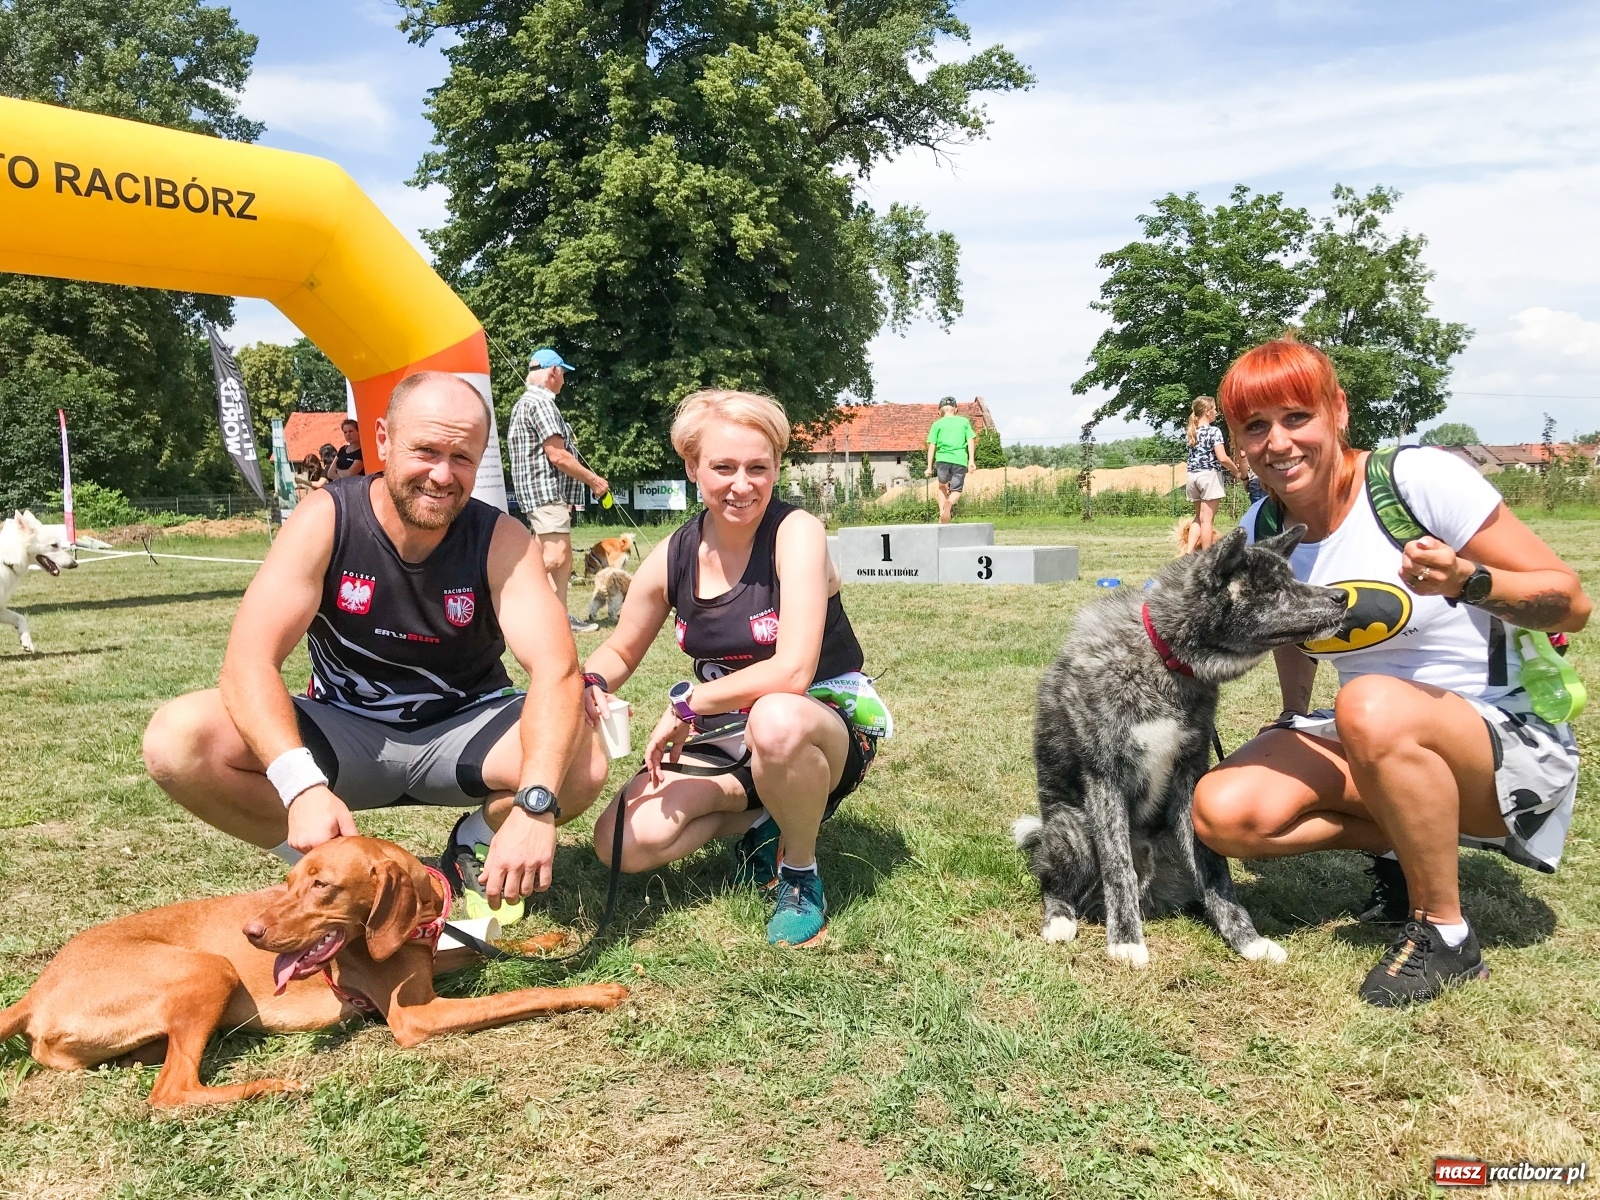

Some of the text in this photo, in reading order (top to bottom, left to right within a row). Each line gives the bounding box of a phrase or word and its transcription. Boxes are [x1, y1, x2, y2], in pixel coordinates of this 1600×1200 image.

[0, 152, 258, 221] O RACIBÓRZ
[637, 485, 680, 496] TropiDog
[880, 533, 893, 562] 1
[856, 566, 919, 577] OSIR RACIBÓRZ
[977, 555, 993, 580] 3
[344, 570, 376, 582] POLSKA
[1401, 627, 1419, 637] TM
